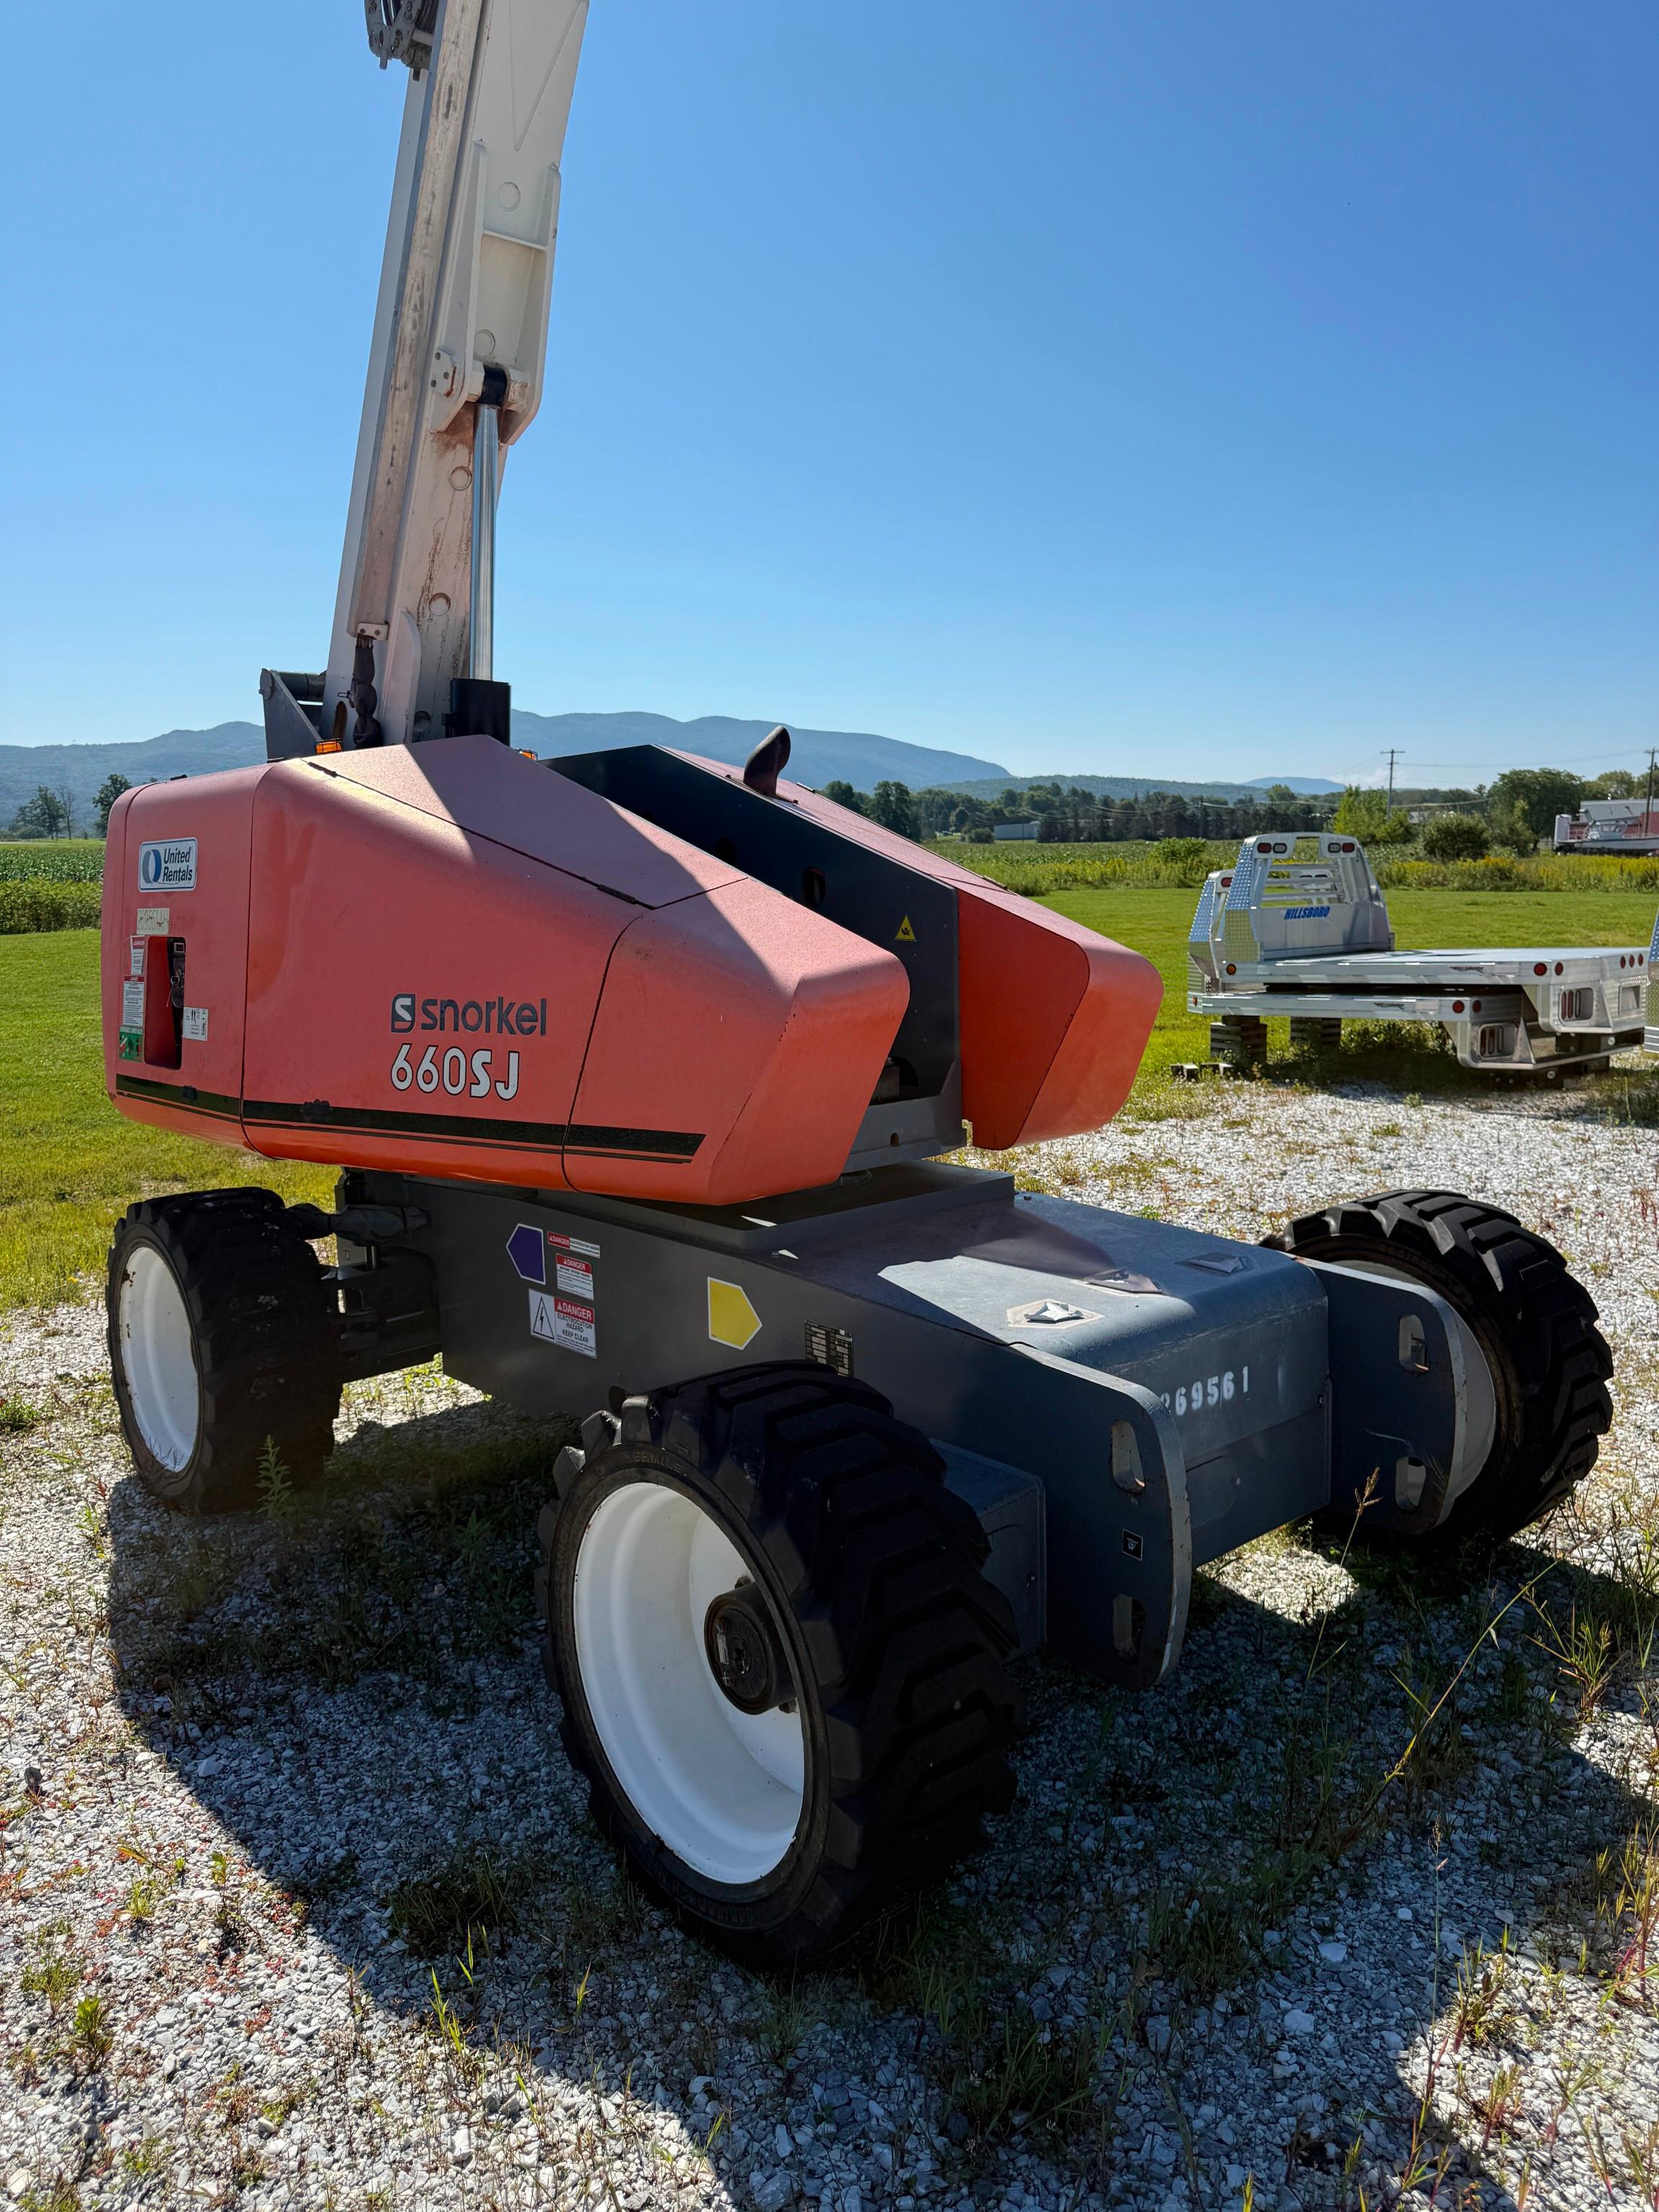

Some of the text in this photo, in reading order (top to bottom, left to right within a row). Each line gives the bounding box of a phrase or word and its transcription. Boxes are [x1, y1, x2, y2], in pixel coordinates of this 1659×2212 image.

[163, 846, 191, 865] United
[162, 865, 193, 882] Rentals
[1284, 906, 1331, 921] HILLSBORO
[420, 996, 547, 1037] snorkel
[390, 1042, 520, 1101] 660SJ
[552, 1235, 569, 1245] DANGER
[567, 1258, 586, 1270] DANGER
[563, 1302, 592, 1320] DANGER
[557, 1313, 593, 1330] ELECTROCUTION
[566, 1323, 584, 1333] HAZARD
[562, 1329, 589, 1343] KEEP CLEAR
